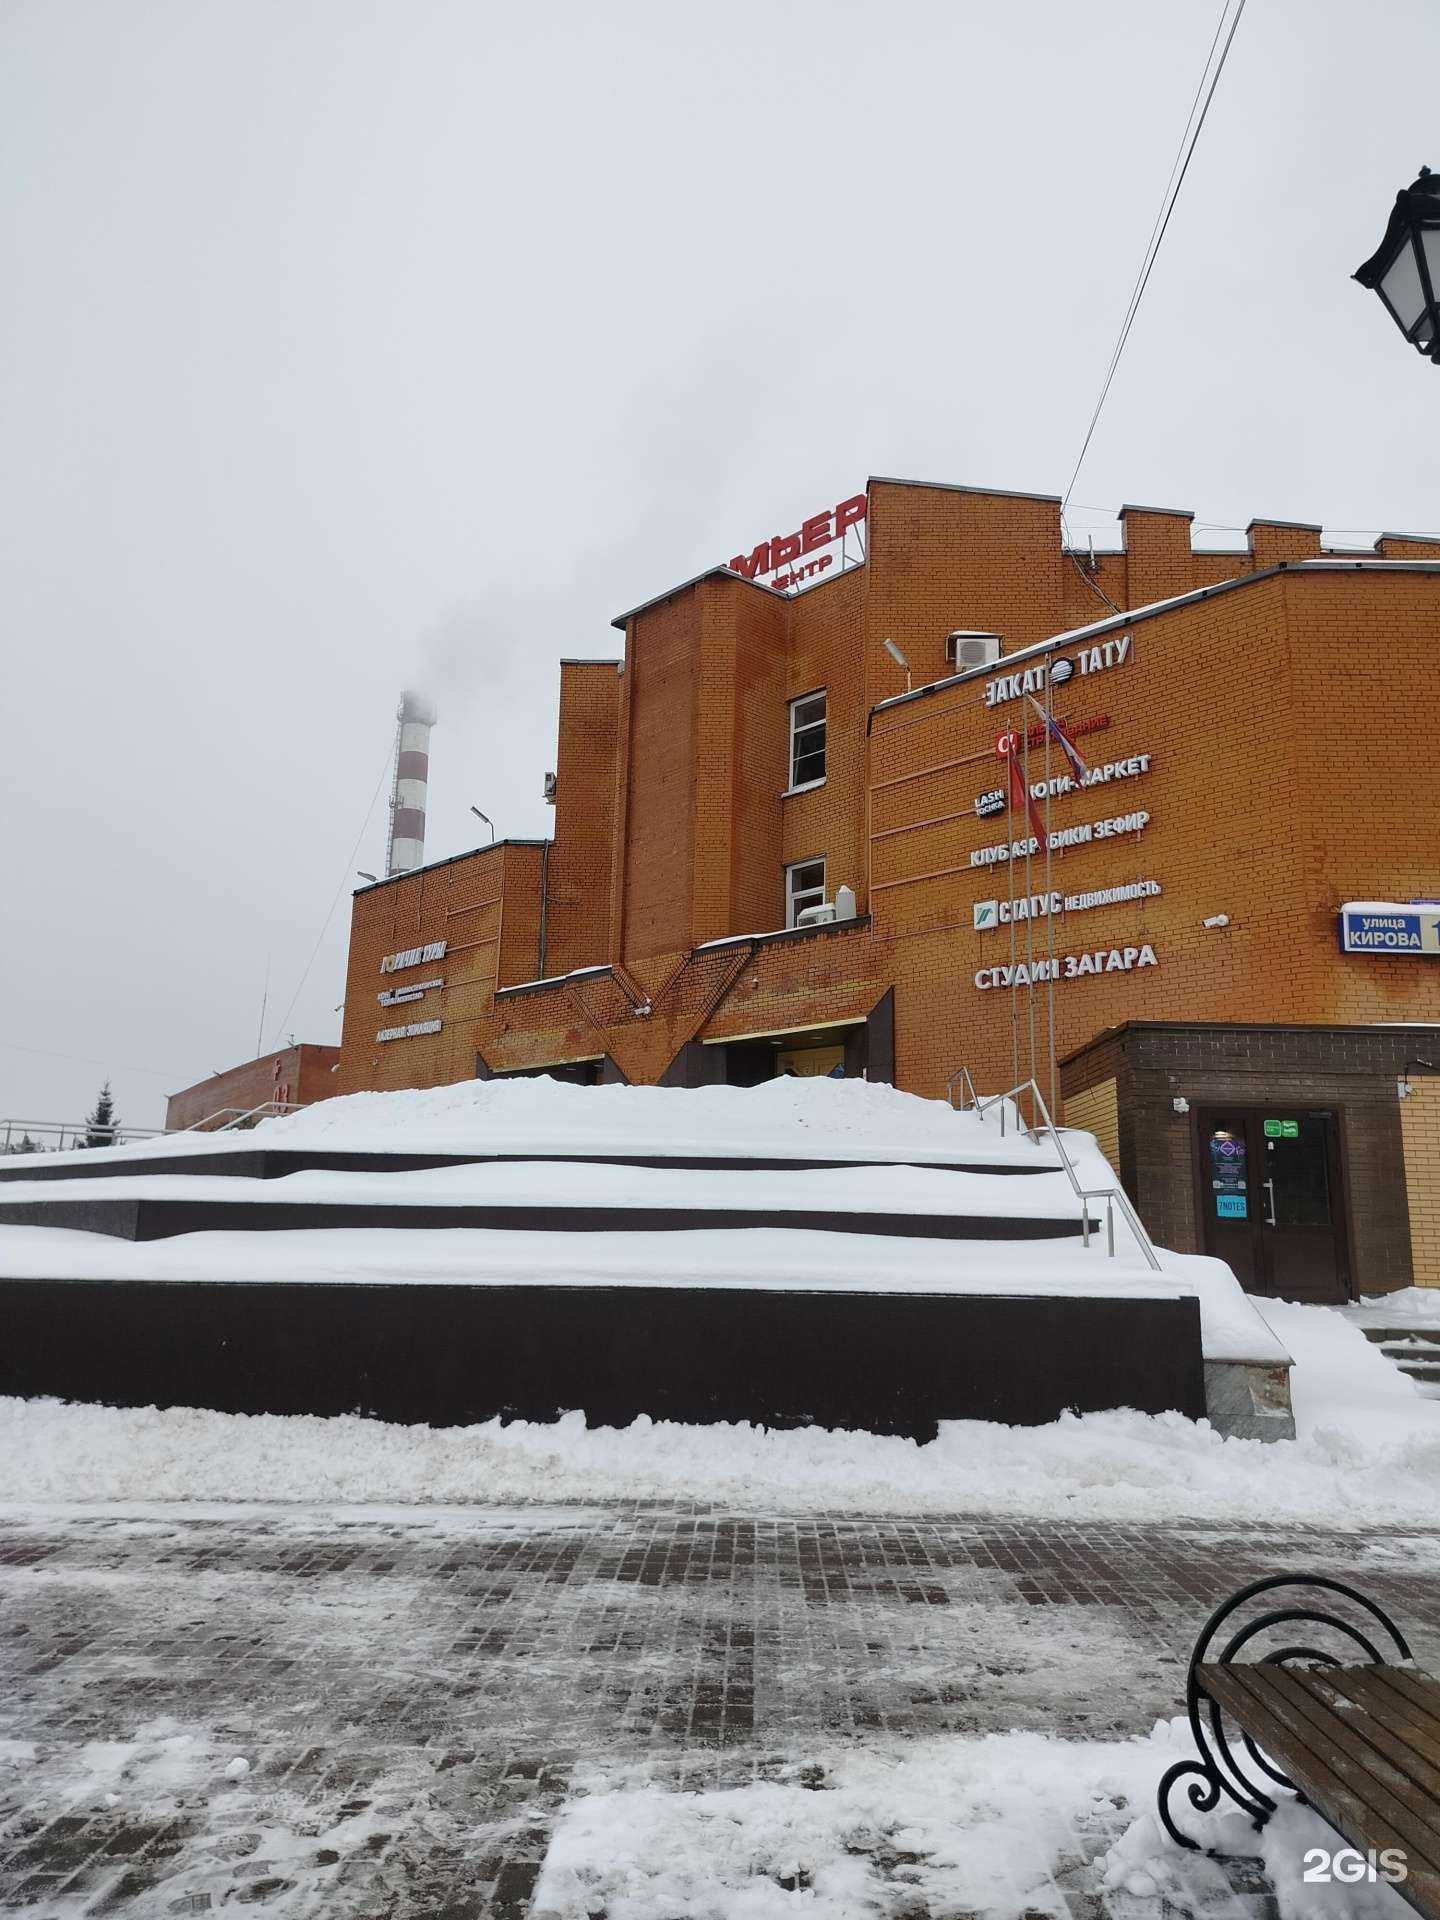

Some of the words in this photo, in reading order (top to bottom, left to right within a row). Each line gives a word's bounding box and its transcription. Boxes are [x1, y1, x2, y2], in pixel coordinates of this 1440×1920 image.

[727, 493, 868, 580] МЬЕР
[771, 554, 833, 590] ЕНТР
[985, 664, 1047, 708] ЗАКАТ
[1077, 635, 1131, 675] ТАТУ
[974, 789, 1005, 808] LASH
[969, 844, 1010, 867] КЛУБ
[1012, 824, 1093, 858] АЭРБИКИ
[1094, 810, 1151, 839] ЗЕФИР
[999, 891, 1064, 923] СТАТУС
[1064, 880, 1162, 911] НЕДВИЖИМОСТЬ
[1350, 931, 1421, 946] КИРОВА
[1362, 918, 1406, 930] улица
[974, 958, 1060, 990] СТУДИЯ
[1064, 944, 1159, 978] ЗАГАРА
[1218, 1200, 1246, 1212] 7NOTES
